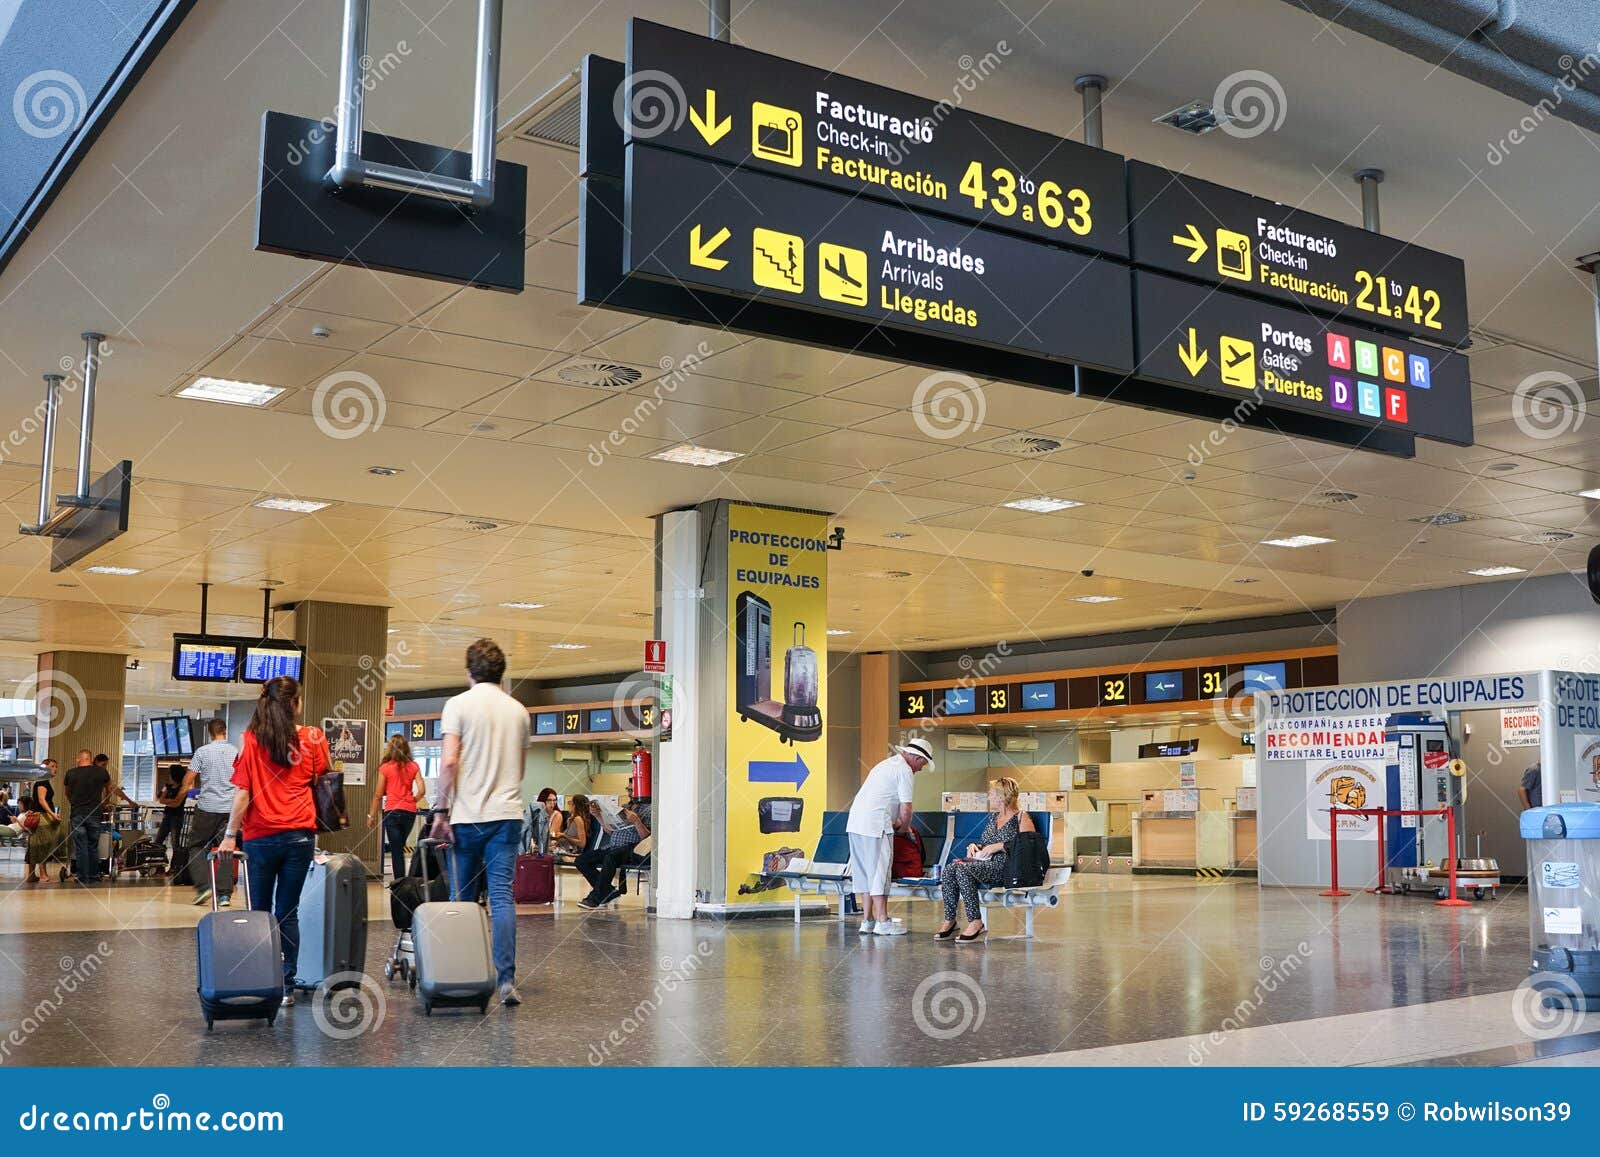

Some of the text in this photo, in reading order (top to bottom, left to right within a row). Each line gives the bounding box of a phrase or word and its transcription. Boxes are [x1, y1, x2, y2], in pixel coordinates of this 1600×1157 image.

[816, 91, 933, 143] Facturació
[816, 121, 888, 157] Check-in
[817, 146, 1092, 236] Facturación 43 to 63
[1022, 204, 1034, 222] a
[1256, 217, 1337, 258] Facturació
[881, 230, 985, 275] Arribades
[1259, 242, 1308, 271] Check-in
[881, 259, 944, 291] Arrivals
[881, 285, 978, 327] Llegadas
[1260, 264, 1442, 330] Facturación 21 to 42
[1394, 305, 1403, 319] a
[1261, 322, 1312, 353] Portes
[1263, 348, 1298, 372] Gates
[1333, 340, 1426, 383] A B C R
[1264, 370, 1324, 402] Puertas
[1334, 381, 1401, 416] D E F
[729, 529, 827, 552] PROTECCION
[769, 553, 788, 566] DE
[736, 569, 819, 588] EQUIPAJES
[1104, 680, 1125, 700] 32
[1202, 671, 1222, 694] 31
[907, 695, 925, 714] 34
[990, 690, 1006, 709] 33
[1270, 677, 1524, 714] PROTECCION DE EQUIPAJES
[566, 714, 579, 730] 37
[1267, 721, 1284, 730] LAS
[1559, 705, 1574, 727] DE
[412, 724, 424, 738] 39
[1267, 749, 1322, 759] PRECINTAR
[1326, 748, 1338, 759] EL
